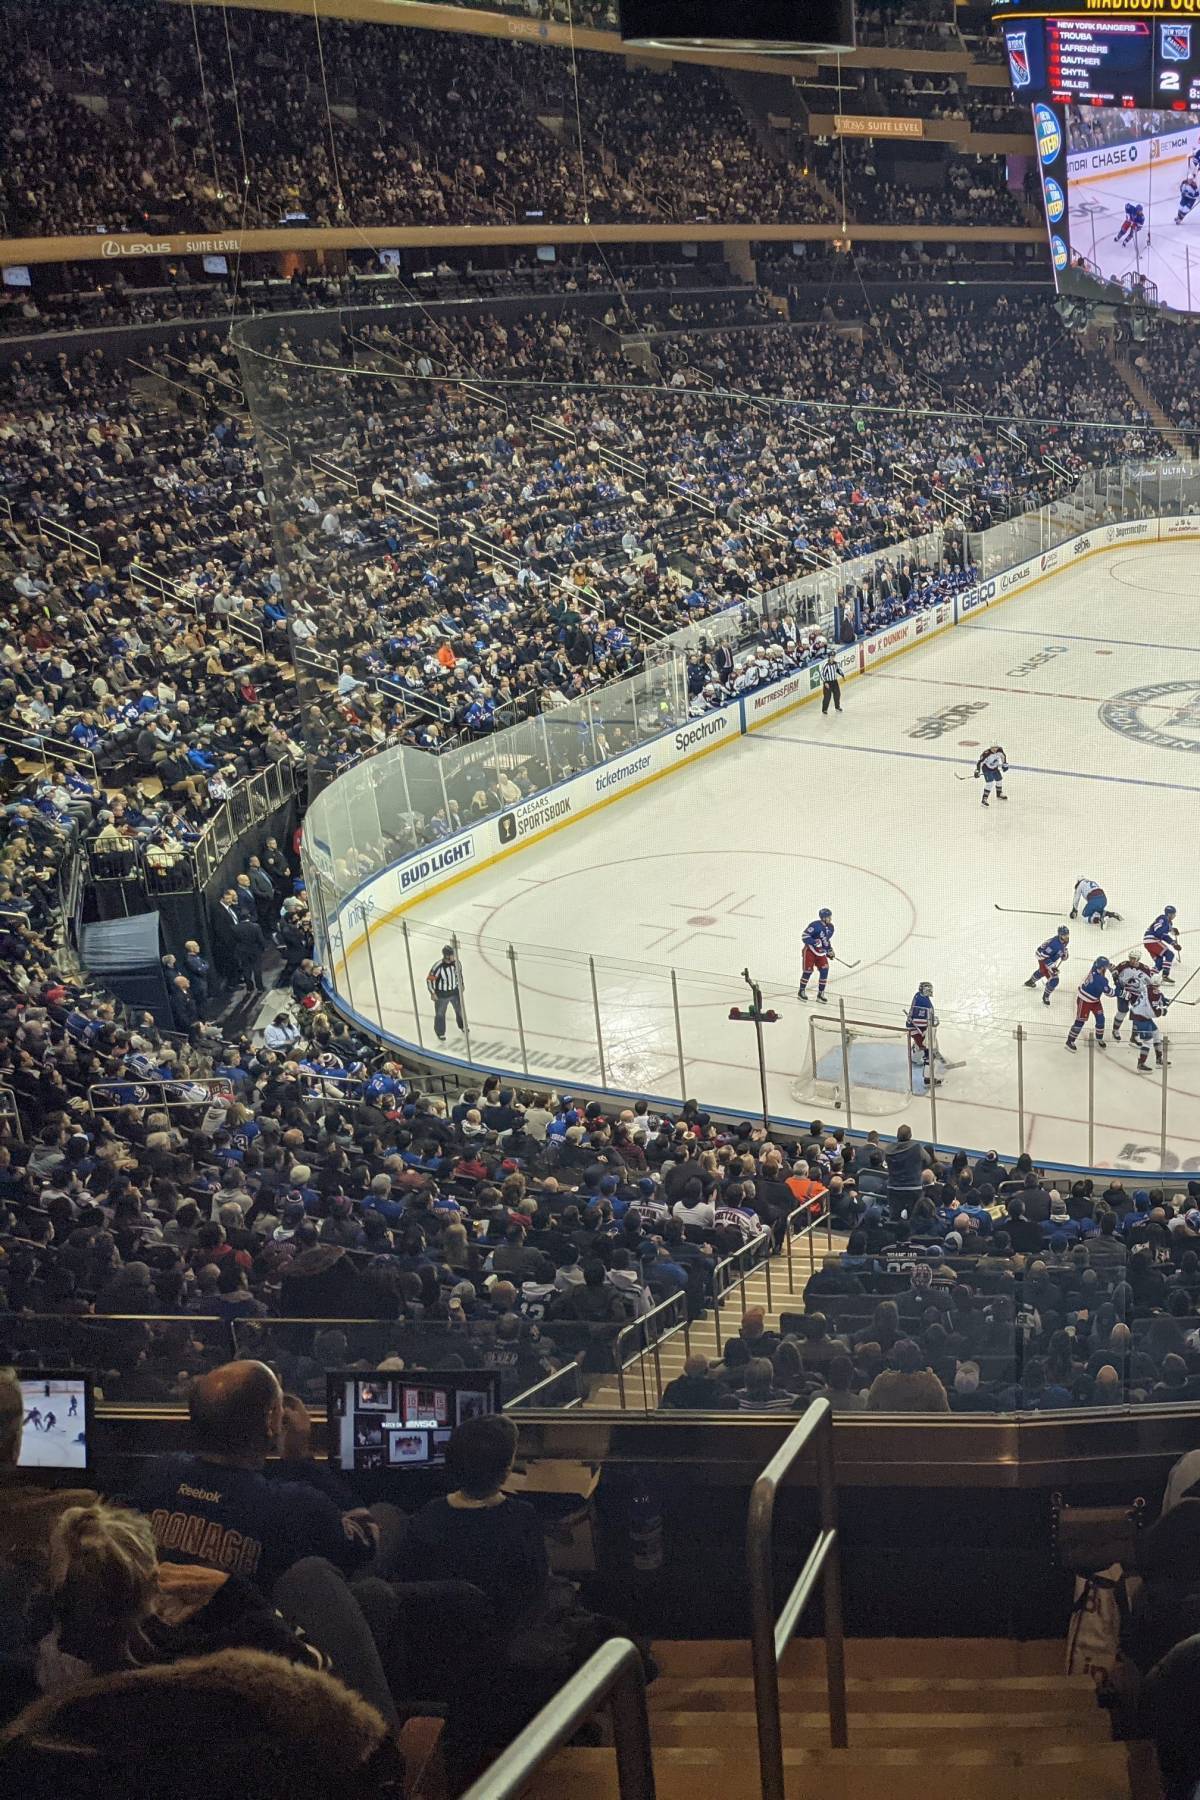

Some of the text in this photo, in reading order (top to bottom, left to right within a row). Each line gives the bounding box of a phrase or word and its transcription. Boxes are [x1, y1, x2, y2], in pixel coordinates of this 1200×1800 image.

[1087, 0, 1163, 9] MADISON
[1060, 32, 1092, 41] TROUBA
[1096, 24, 1136, 32] RANGERS
[1060, 56, 1101, 66] GAUTHIER
[1061, 69, 1089, 77] CHYTIL
[1159, 71, 1180, 90] 2
[1061, 80, 1090, 89] MILLER
[867, 121, 920, 132] SUITE LEVEL
[1161, 137, 1188, 151] BETMGM
[1092, 149, 1127, 168] CHASE
[121, 240, 239, 255] LEXUS SUITE LEVEL
[1008, 568, 1030, 584] LEXUS
[962, 581, 996, 611] GEICO
[883, 626, 909, 647] DUNKIN'
[1005, 652, 1058, 678] CHASE
[754, 679, 799, 709] MATTRESSFIRM
[675, 716, 725, 752] Spectrum
[595, 754, 651, 791] ticketmaster
[516, 796, 549, 818] CAESARS
[518, 797, 571, 836] SPORTSBOOK
[401, 840, 471, 888] BUD LIGHT
[178, 1484, 223, 1503] Reebok
